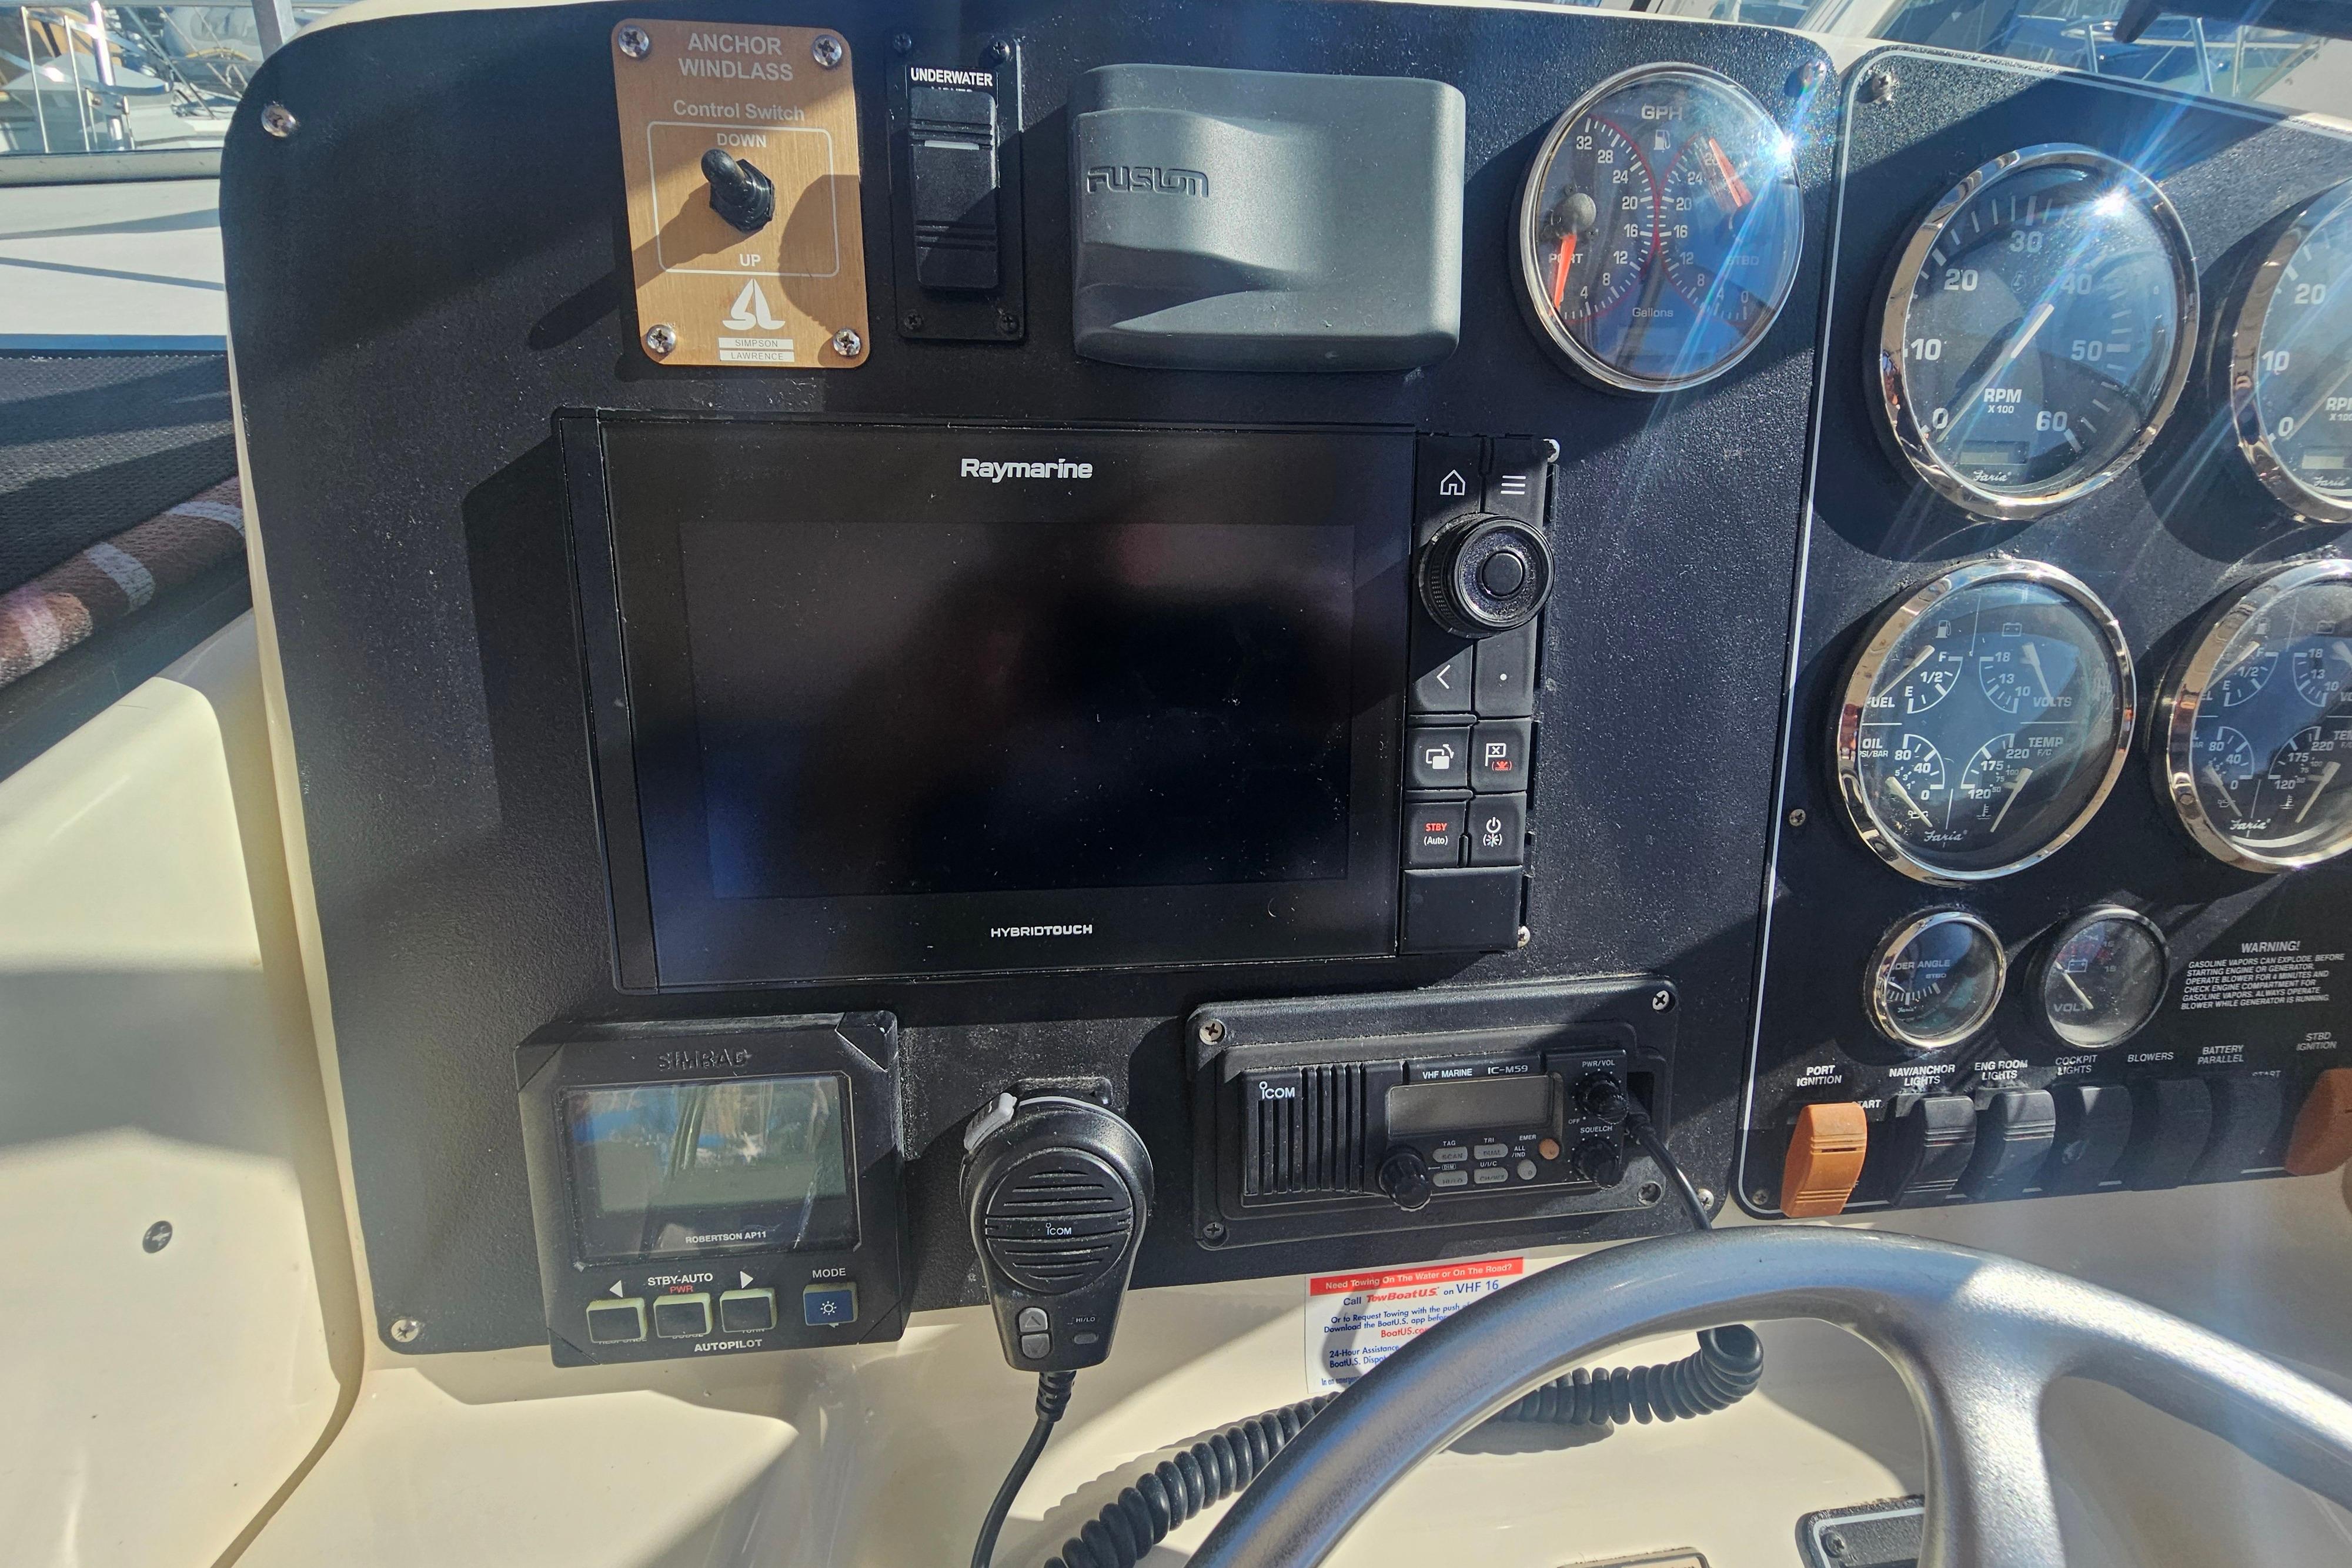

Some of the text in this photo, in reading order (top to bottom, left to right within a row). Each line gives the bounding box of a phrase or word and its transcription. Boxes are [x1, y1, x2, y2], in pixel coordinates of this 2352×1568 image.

[688, 33, 781, 56] ANCHOR
[678, 58, 793, 81] WINDLASS
[910, 68, 993, 87] UNDERWATER
[673, 100, 805, 121] Control Switch
[1642, 105, 1682, 120] GPH
[717, 133, 767, 148] DOWN
[1576, 136, 1592, 150] 32
[1598, 150, 1613, 162] 28
[1087, 166, 1209, 198] FUSION
[1613, 171, 1628, 183] 24
[1688, 171, 1703, 185] 24
[1622, 196, 1638, 209] 20
[1676, 198, 1692, 211] 20
[1624, 225, 1638, 237] 16
[1674, 225, 1688, 238] 16
[2010, 230, 2042, 252] 30
[740, 254, 760, 266] UP
[1613, 252, 1628, 264] 12
[1603, 273, 1611, 286] 8
[1944, 269, 1977, 291] 20
[2060, 273, 2093, 295] 40
[1581, 286, 1588, 298] 4
[2294, 284, 2326, 304] 20
[1632, 306, 1673, 318] Gallons
[735, 339, 778, 348] SIMPSON
[1910, 339, 1941, 360] 10
[730, 352, 784, 360] LAWRENCE
[2072, 340, 2103, 361] 50
[2262, 351, 2290, 371] 10
[1984, 388, 2022, 403] RPM
[1932, 408, 1949, 429] 0
[2036, 412, 2068, 432] 60
[961, 459, 1093, 483] Raymarine
[1939, 651, 1947, 661] F
[1995, 651, 2010, 662] 18
[2308, 649, 2323, 658] 18
[1920, 671, 1942, 683] 1/2
[2239, 667, 2259, 677] 1/2
[2311, 670, 2326, 679] 13
[1999, 674, 2014, 684] 13
[1905, 686, 1913, 697] E
[2015, 686, 2031, 697] 10
[2033, 696, 2072, 707] VOLTS
[1862, 738, 1883, 749] OIL
[2029, 737, 2064, 748] TEMP
[2209, 742, 2224, 751] 80
[2311, 741, 2334, 751] 220
[1895, 750, 1912, 761] 80
[2006, 748, 2029, 760] 220
[2226, 754, 2241, 764] 40
[2288, 753, 2308, 763] 175
[1913, 763, 1931, 773] 40
[1981, 761, 2004, 771] 175
[2274, 780, 2296, 790] 120
[1921, 790, 1929, 800] 0
[1968, 790, 1990, 800] 120
[1426, 823, 1447, 831] STBY
[1424, 835, 1448, 845] (Auto)
[991, 924, 1093, 938] HYBRIDTOUCH
[2241, 941, 2301, 953] WARNING!
[1917, 959, 1951, 968] ANGLE
[2189, 954, 2345, 969] GASOLINE VAPORS CAN BEFORE
[2186, 977, 2220, 985] OPERATE
[2221, 975, 2253, 984] BLOWER
[2278, 971, 2312, 979] MINUTES
[2187, 969, 2224, 977] STARTING
[2225, 967, 2254, 975] ENGINE
[2184, 985, 2210, 994] CHECK
[2241, 981, 2299, 989] COMPARTMENT
[2183, 993, 2221, 1001] GASOLINE
[2287, 987, 2321, 995] OPERATE
[2181, 1001, 2213, 1009] BLOWER
[2216, 999, 2239, 1008] WHILE
[2240, 997, 2286, 1006] GENERATOR
[2305, 1032, 2332, 1042] STBD
[2202, 1045, 2244, 1055] BATTERY
[2296, 1041, 2337, 1051] IGNITION
[2055, 1055, 2098, 1066] COCKPIT
[2127, 1052, 2174, 1063] BLOWERS
[2197, 1054, 2244, 1065] PARALLEL
[1806, 1065, 1835, 1076] PORT
[1889, 1064, 1956, 1077] NAV/ANCHOR
[1975, 1059, 2028, 1072] ENG ROOM
[2057, 1065, 2092, 1075] LIGHTS
[1422, 1065, 1528, 1079] VHF MARINE IC-M59
[1982, 1070, 2018, 1081] LIGHTS
[1796, 1075, 1842, 1086] IGNITION
[1904, 1076, 1941, 1086] LIGHTS
[686, 1231, 766, 1243] ROBERTSON AP11
[812, 1268, 846, 1278] MODE
[1326, 1281, 1348, 1289] Need
[1350, 1278, 1380, 1287] Towing
[1415, 1271, 1439, 1281] Water
[1486, 1263, 1512, 1273] Road?
[647, 1273, 713, 1287] STBY-AUTO
[670, 1285, 693, 1293] PWR
[1343, 1296, 1362, 1306] Call
[1456, 1281, 1481, 1293] VHF
[1486, 1279, 1499, 1290] 16
[1353, 1312, 1381, 1322] Request
[1384, 1310, 1409, 1319] Towing
[1443, 1303, 1459, 1313] push
[1324, 1323, 1361, 1333] Download
[1378, 1318, 1408, 1327] BoatU.S.
[1411, 1316, 1425, 1325] app
[694, 1339, 762, 1352] AUTOPILOT
[1329, 1349, 1359, 1358] 24-Hour
[1329, 1358, 1361, 1368] BoatU.S.
